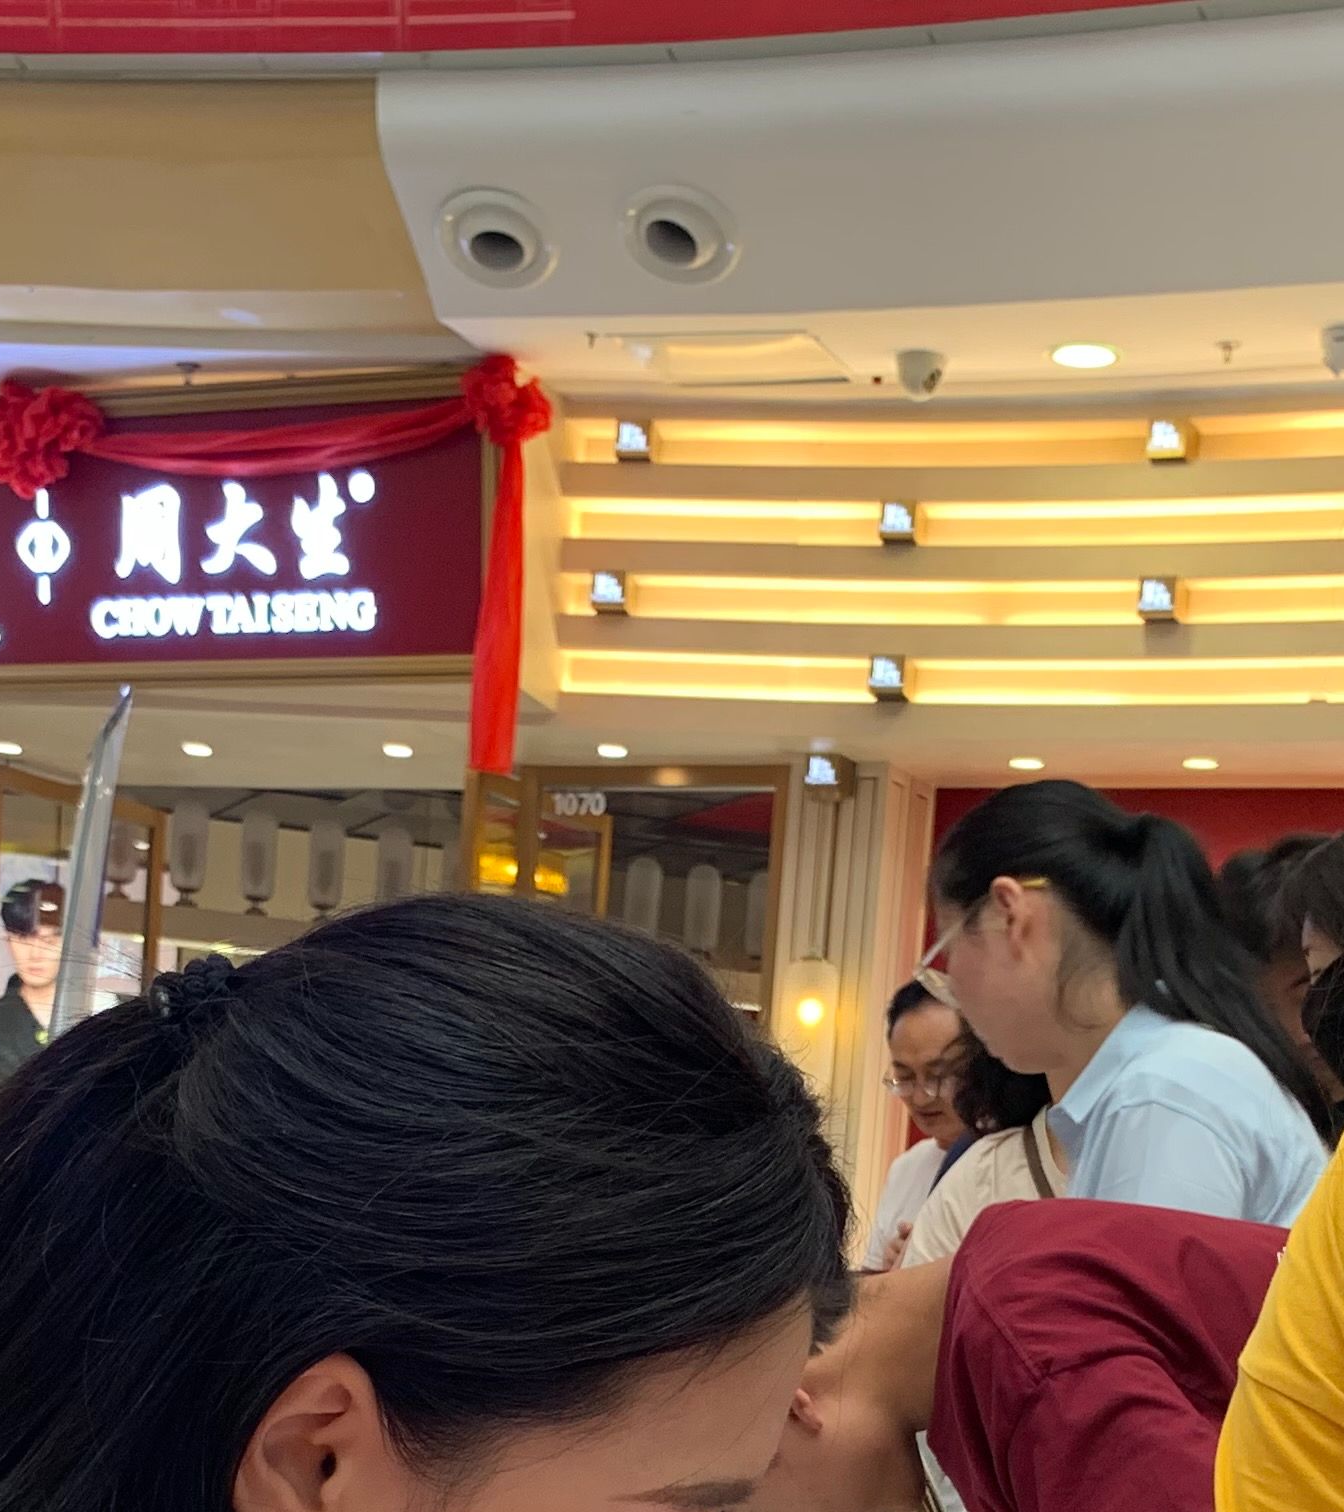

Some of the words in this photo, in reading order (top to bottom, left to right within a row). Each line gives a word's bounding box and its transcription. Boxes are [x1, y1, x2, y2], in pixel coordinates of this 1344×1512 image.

[113, 471, 350, 585] 周大生
[90, 595, 205, 639] CHOW
[205, 592, 270, 634] TAI
[270, 588, 377, 633] SENG
[553, 792, 608, 816] 1070
